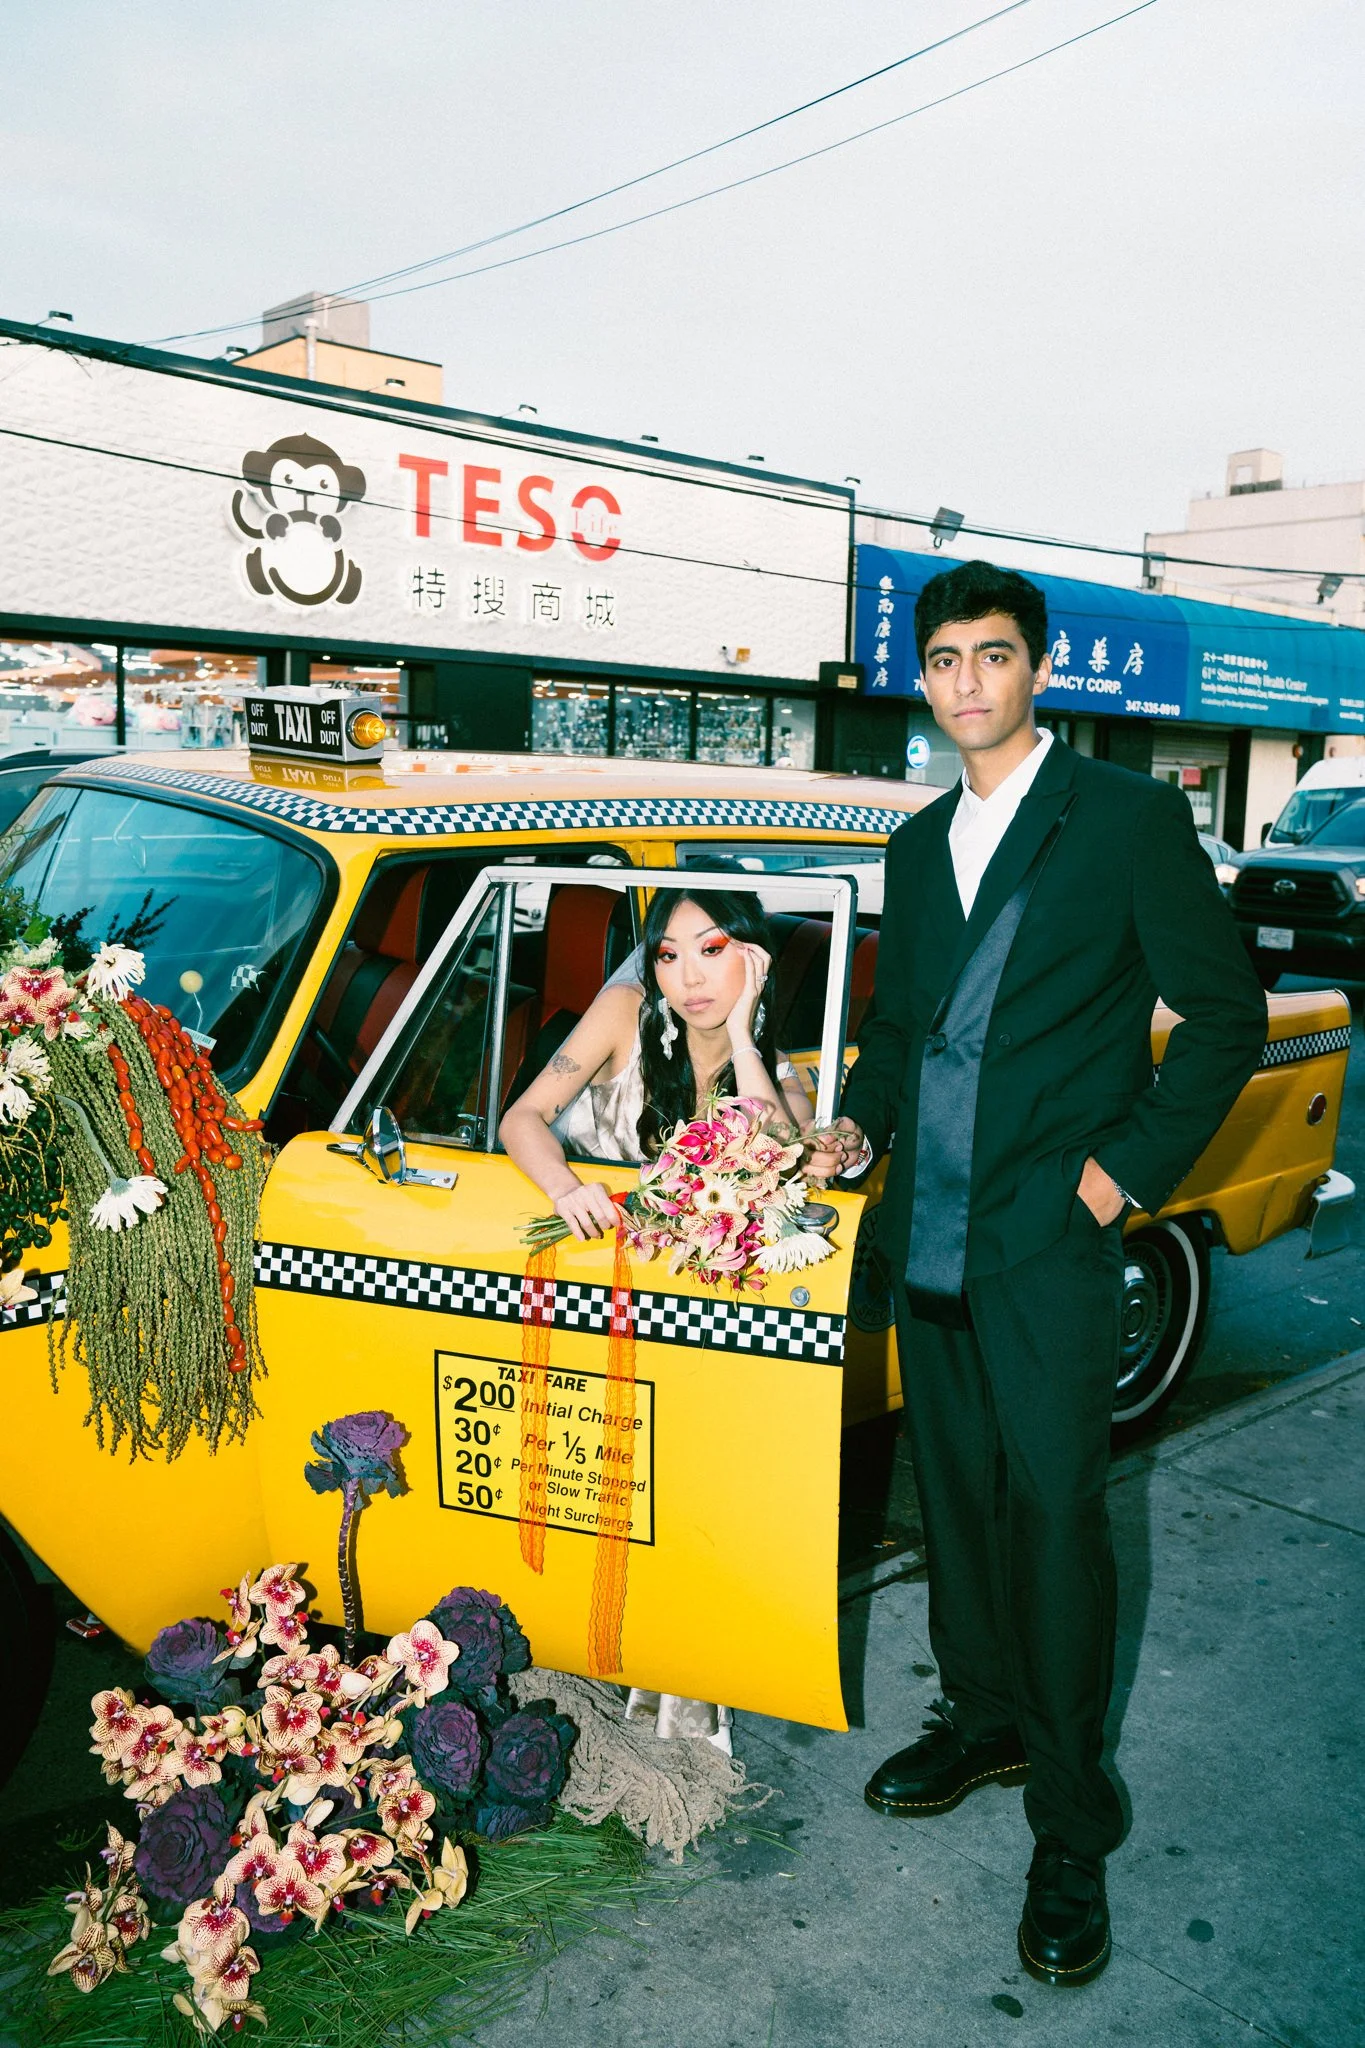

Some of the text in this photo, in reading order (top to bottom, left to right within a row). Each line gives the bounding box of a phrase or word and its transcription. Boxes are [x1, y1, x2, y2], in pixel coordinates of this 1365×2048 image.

[398, 453, 622, 561] TESO
[412, 566, 615, 626] 特搜商城
[1086, 678, 1123, 695] CORP.
[251, 703, 264, 717] OFF
[274, 704, 312, 744] TAXI
[321, 710, 336, 725] OFF
[251, 722, 268, 736] DUTY
[320, 730, 340, 746] DUTY
[498, 1366, 588, 1392] TAXI FARE
[524, 1398, 573, 1418] Initial
[578, 1406, 643, 1432] Charge
[455, 1417, 501, 1445] 30¢
[524, 1433, 556, 1451] Per
[595, 1445, 632, 1464] Mile
[456, 1450, 647, 1492] 20¢ Per Minute Stopped
[458, 1481, 633, 1532] 50¢ Night Surcharge
[529, 1481, 628, 1506] or Slow Traffic
